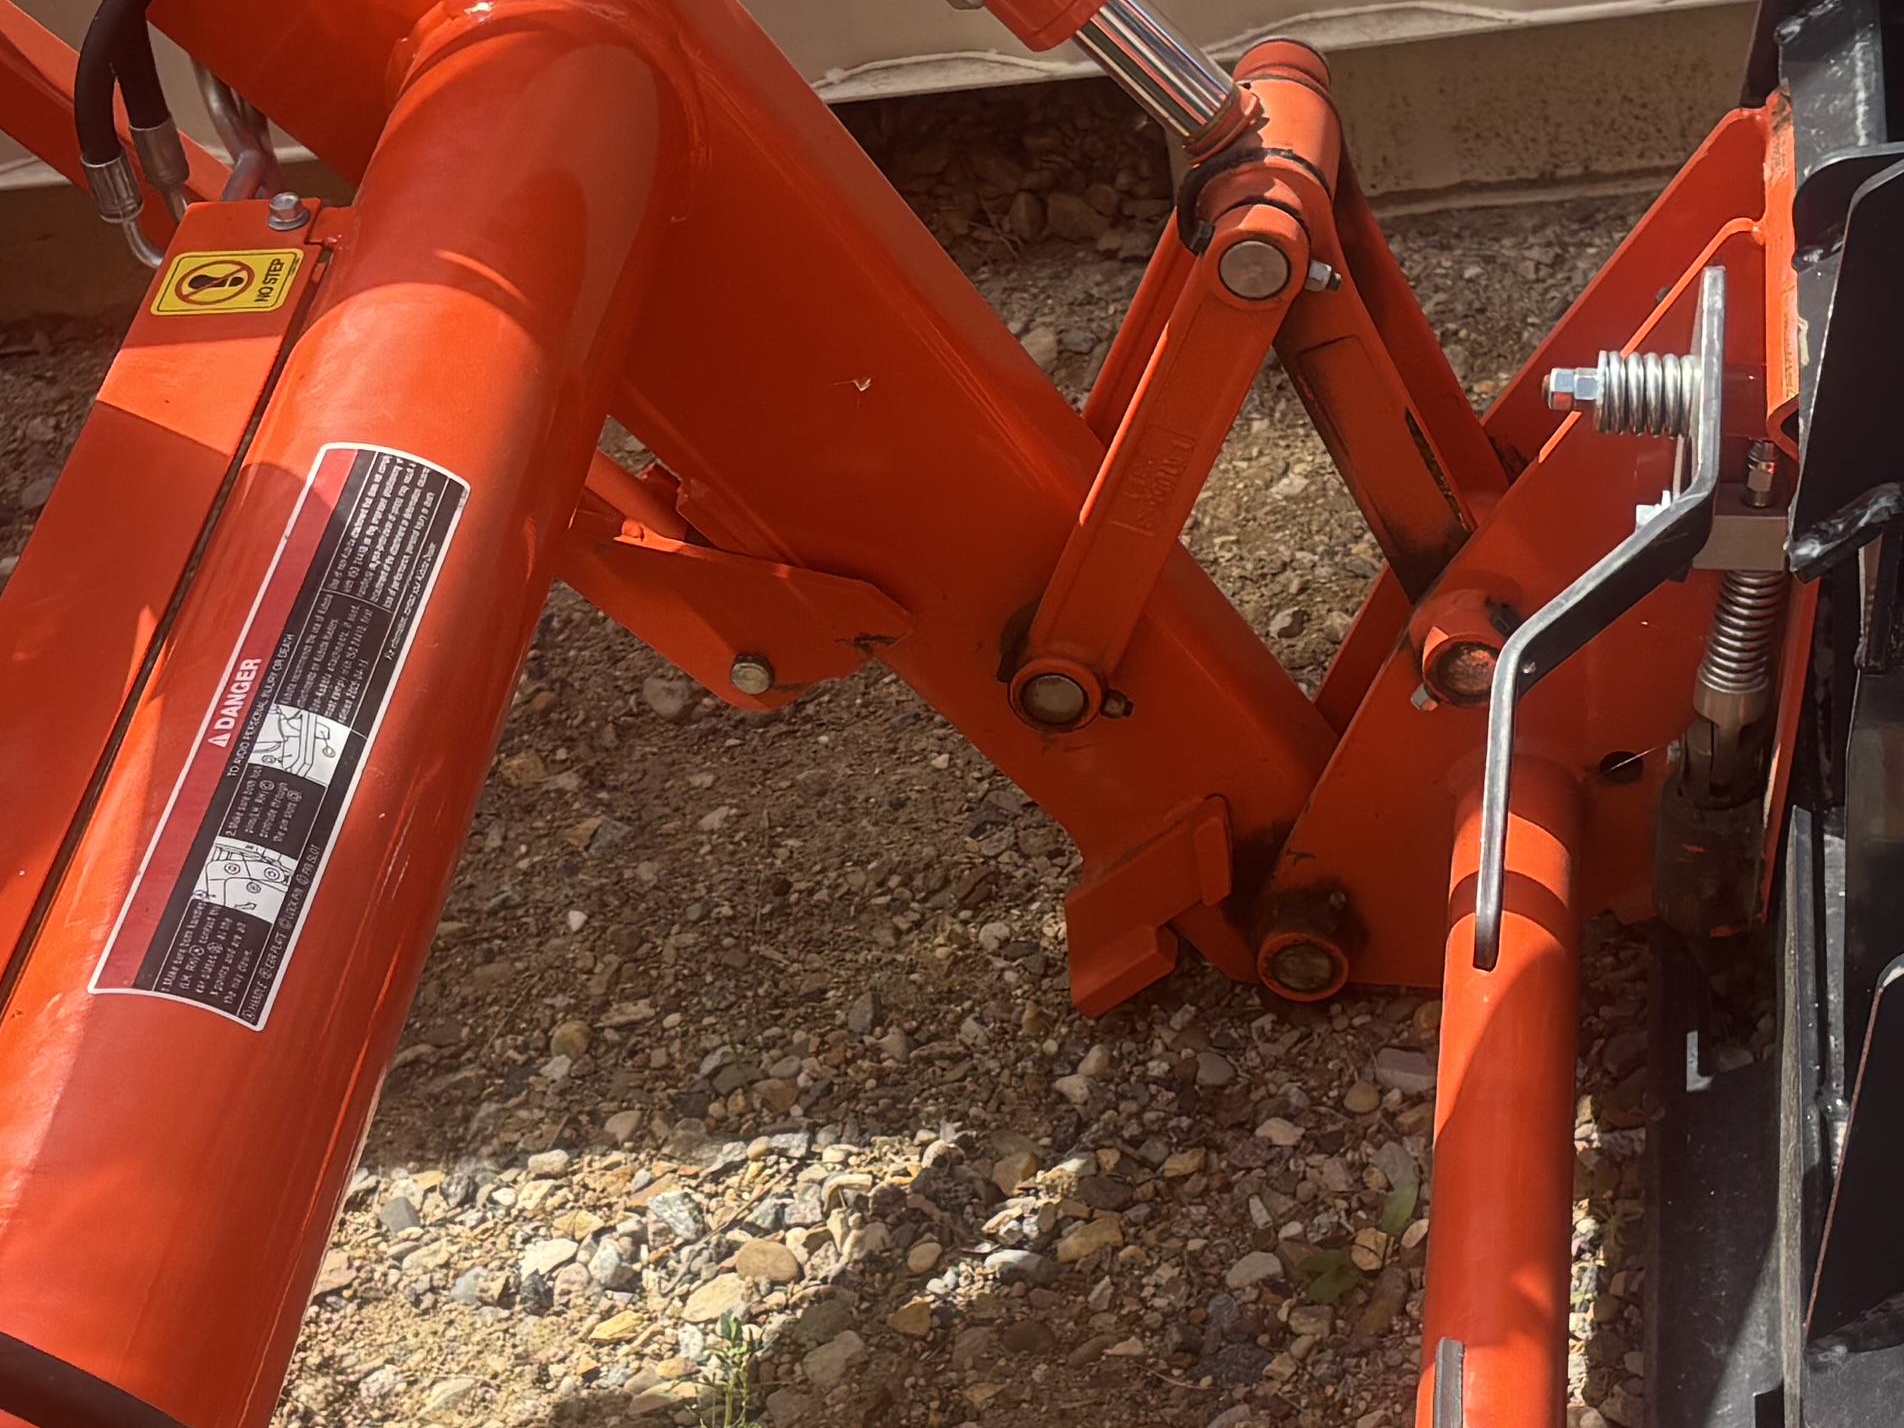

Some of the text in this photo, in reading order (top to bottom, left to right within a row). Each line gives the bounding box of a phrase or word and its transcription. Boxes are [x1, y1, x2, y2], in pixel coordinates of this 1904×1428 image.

[254, 258, 285, 302] NO STEP
[276, 632, 295, 658] DEATH
[215, 656, 263, 730] DANGER
